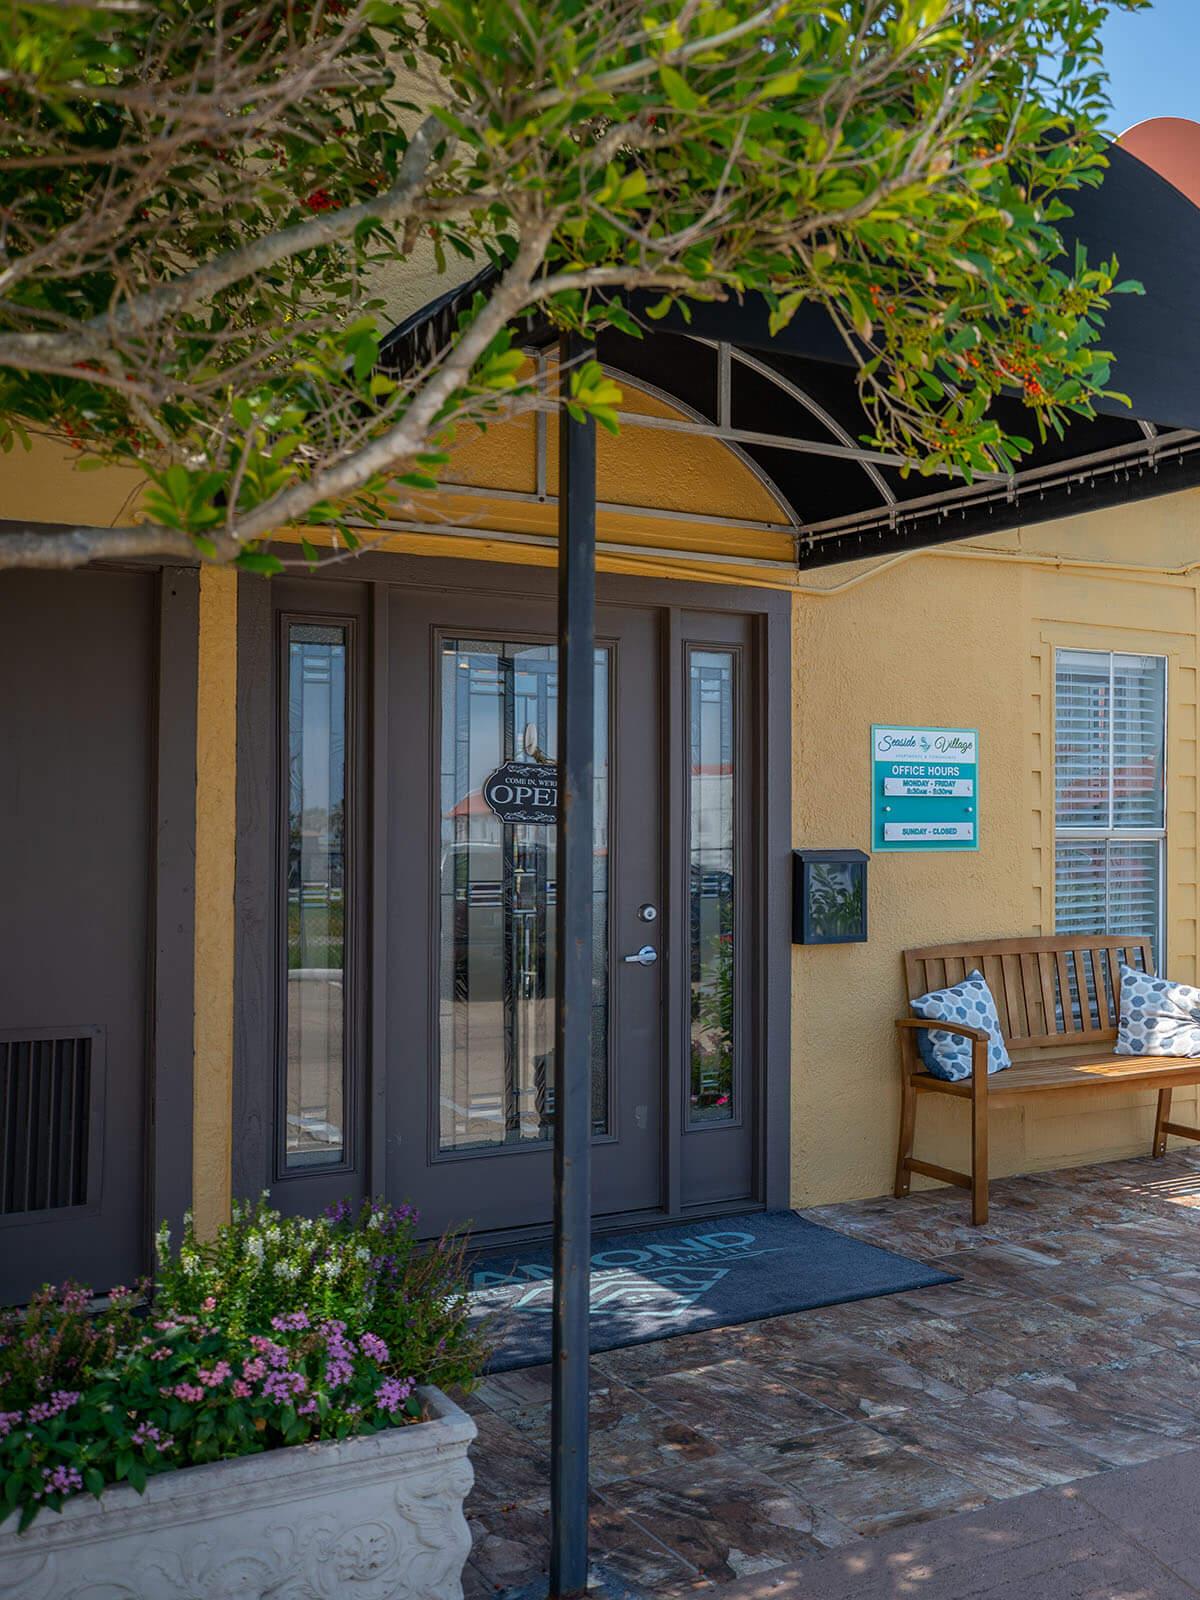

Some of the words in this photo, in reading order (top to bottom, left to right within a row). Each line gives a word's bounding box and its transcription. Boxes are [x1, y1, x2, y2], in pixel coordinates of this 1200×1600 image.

[878, 736, 916, 752] Seaside
[934, 736, 972, 754] Village
[892, 766, 925, 776] OFFICE
[928, 766, 960, 776] HOURS
